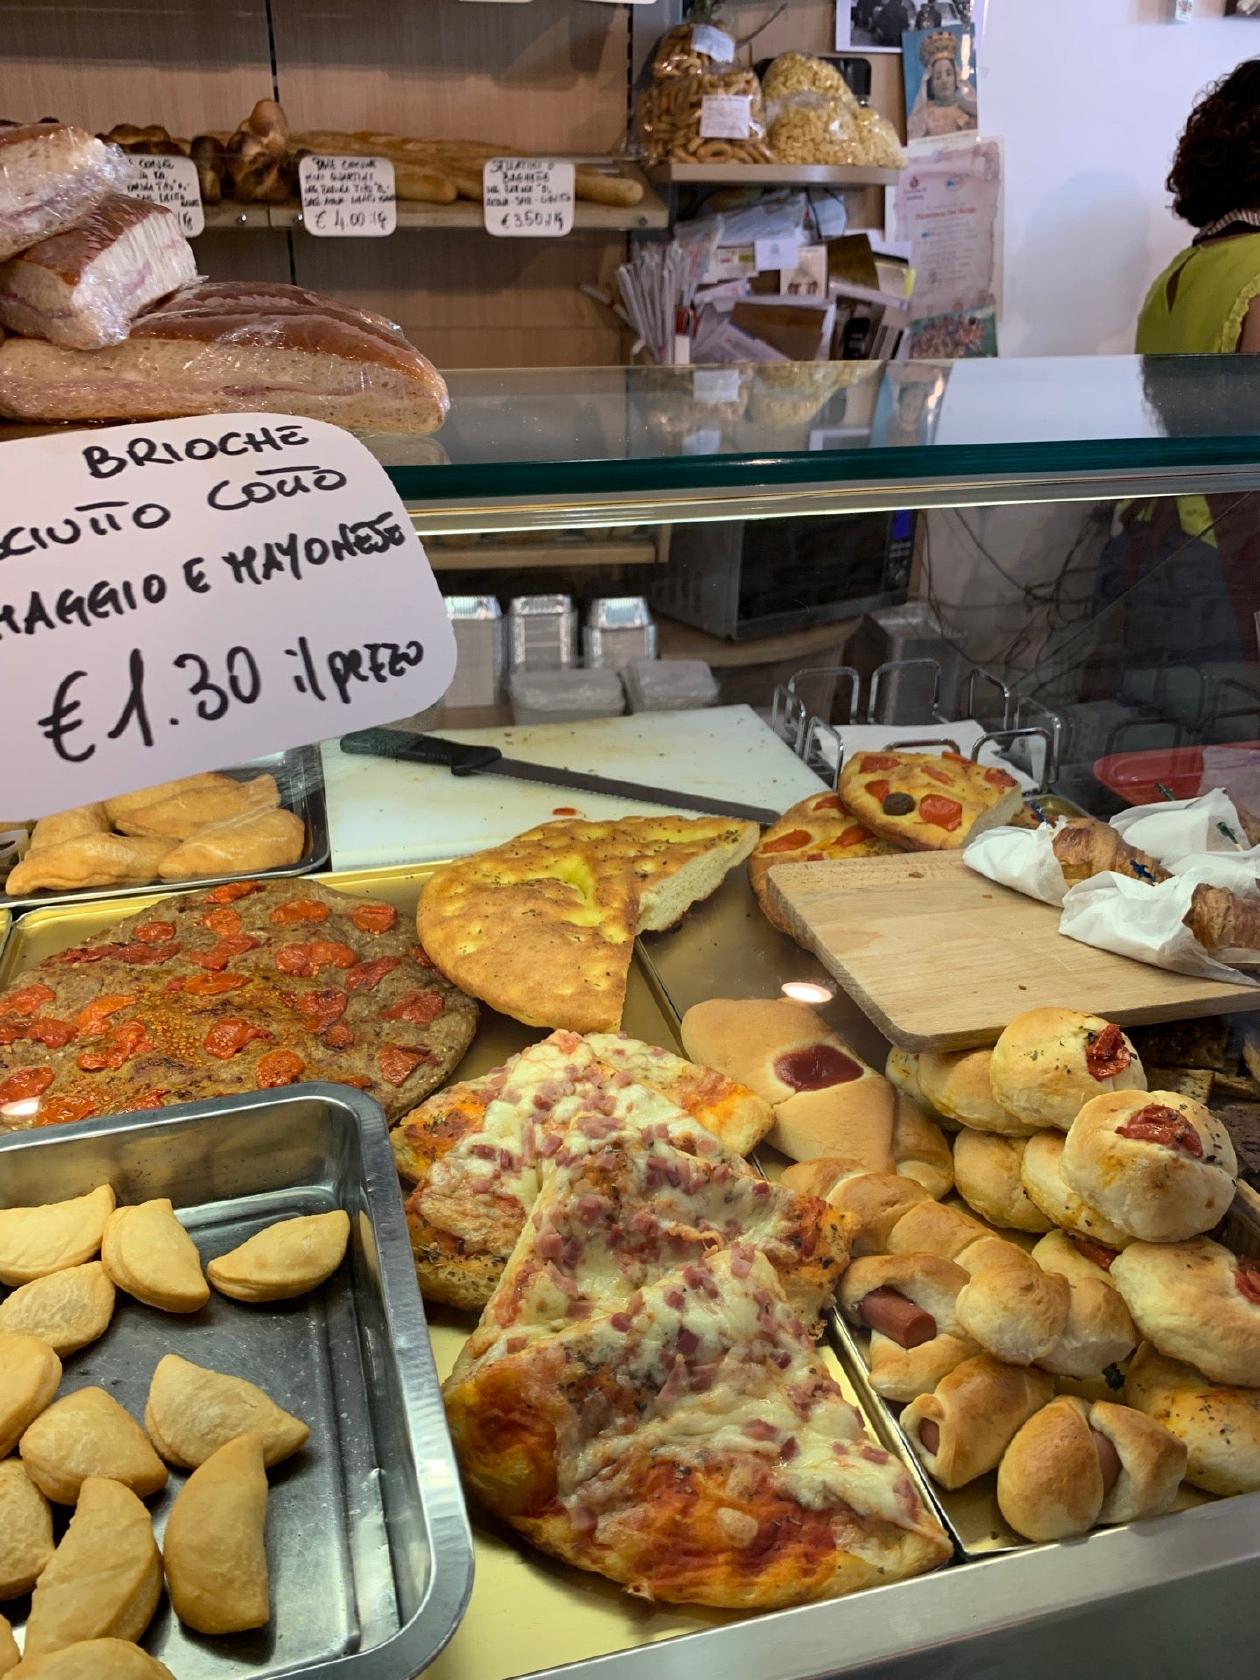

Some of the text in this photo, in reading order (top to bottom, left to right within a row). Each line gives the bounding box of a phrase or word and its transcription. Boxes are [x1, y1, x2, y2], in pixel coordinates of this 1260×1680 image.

[82, 425, 310, 480] BRIOCHE
[207, 465, 348, 511] COTTO
[183, 557, 212, 594] E
[221, 511, 406, 585] MAYONESE
[284, 636, 326, 701] il
